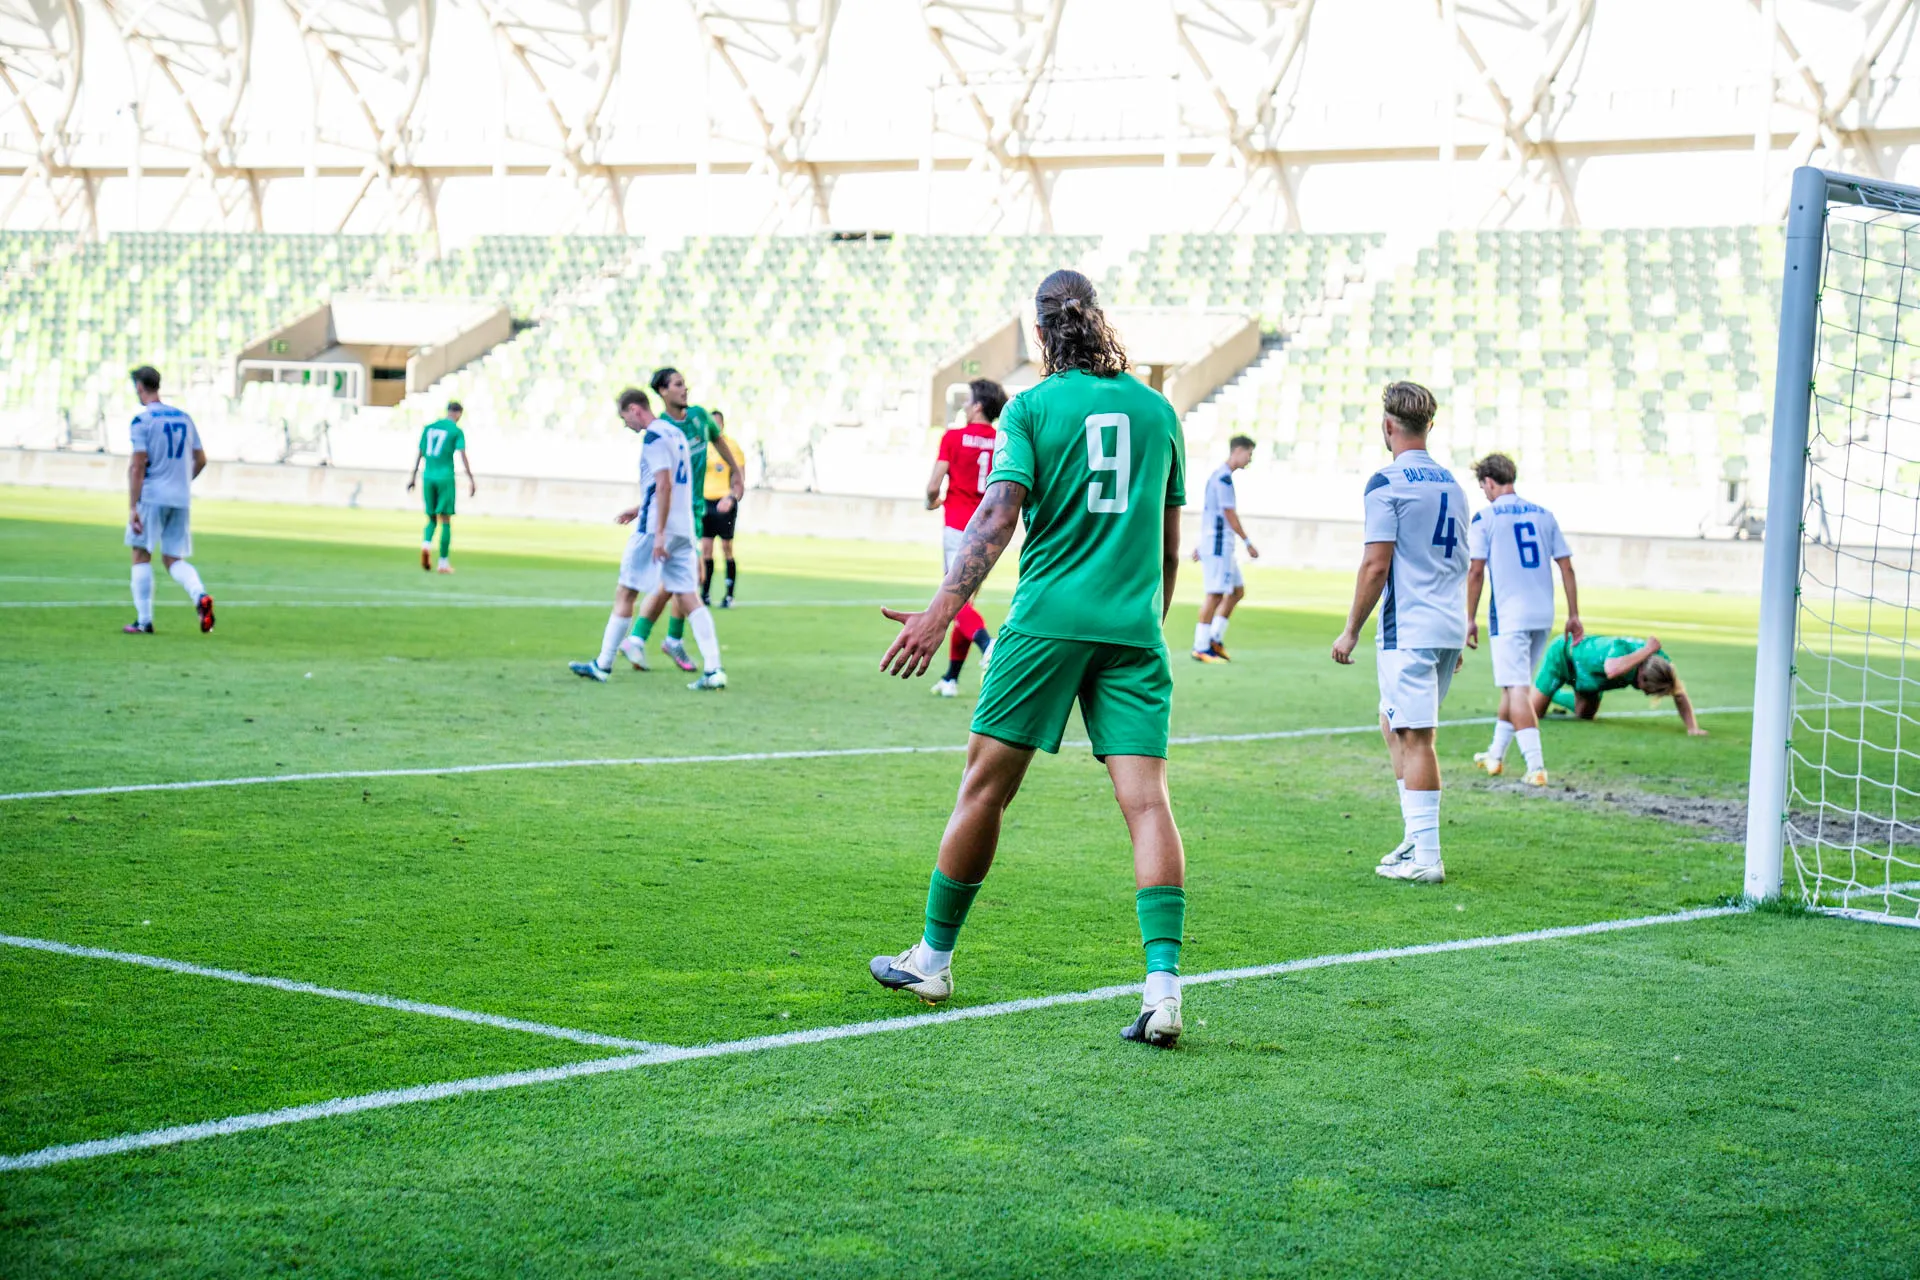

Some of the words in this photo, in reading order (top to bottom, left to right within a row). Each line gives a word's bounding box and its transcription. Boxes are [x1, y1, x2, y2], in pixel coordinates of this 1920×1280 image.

[163, 422, 187, 459] 17
[426, 427, 448, 457] 17
[1085, 413, 1131, 513] 9
[1432, 492, 1458, 558] 4
[1514, 521, 1540, 568] 6
